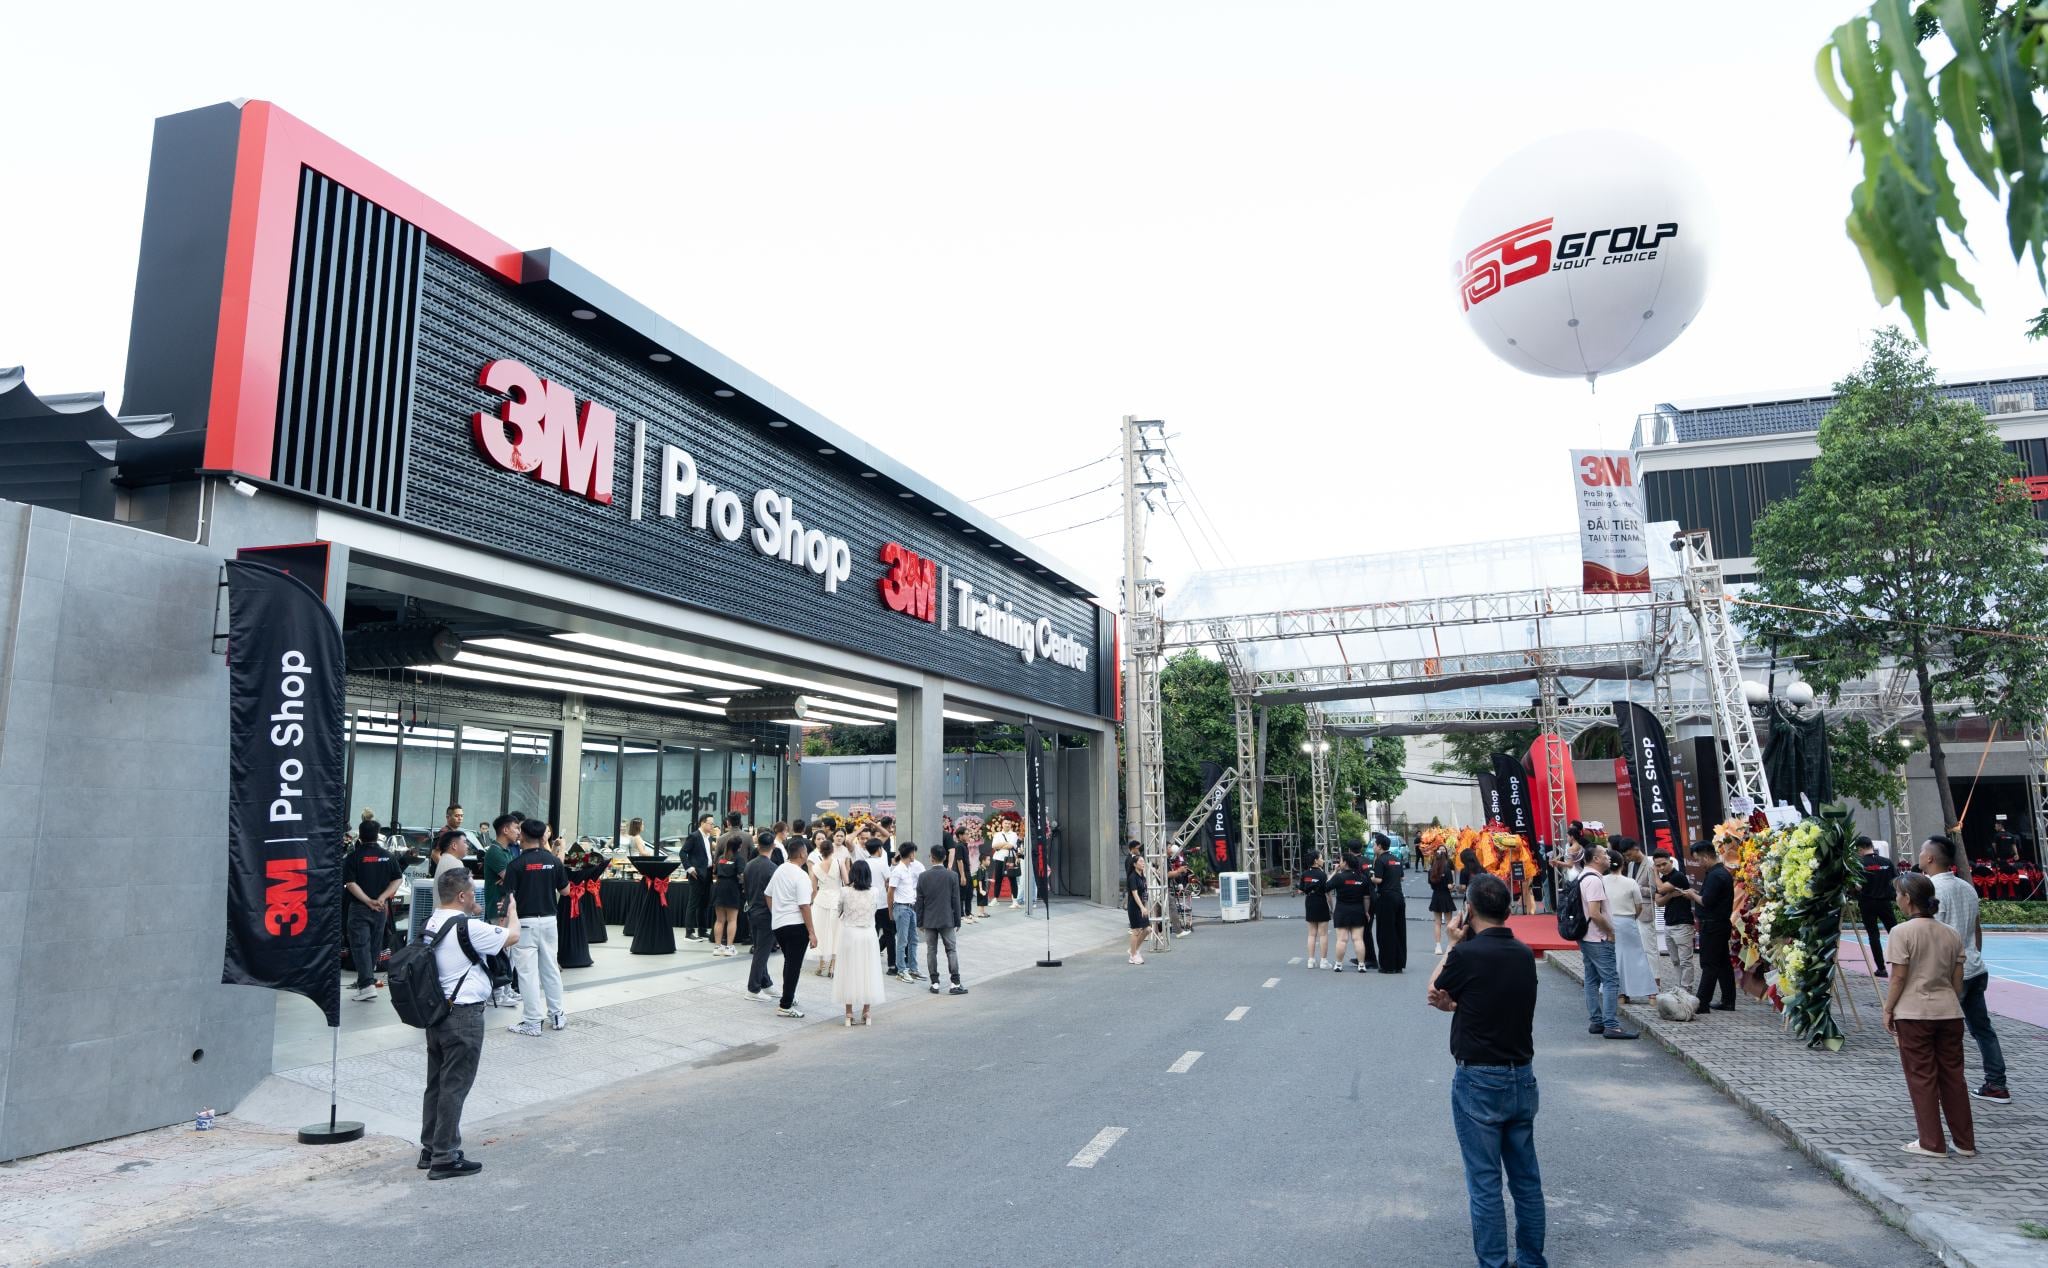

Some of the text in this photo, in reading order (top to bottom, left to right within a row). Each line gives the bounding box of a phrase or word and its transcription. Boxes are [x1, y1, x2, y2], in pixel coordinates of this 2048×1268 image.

[471, 358, 851, 593] 3M Pro Shop
[1580, 455, 1632, 487] 3M
[1584, 500, 1635, 508] Trainig Cnter
[1620, 534, 1640, 542] NAM
[878, 541, 1089, 672] 3M Training Center
[1642, 737, 1657, 781] Shop
[264, 649, 312, 937] 3M Pro Shop
[1491, 790, 1499, 813] Shop
[1510, 776, 1525, 827] Pro Shop
[1652, 785, 1665, 814] Pro
[1215, 812, 1224, 831] Pro
[1215, 839, 1227, 862] 3M
